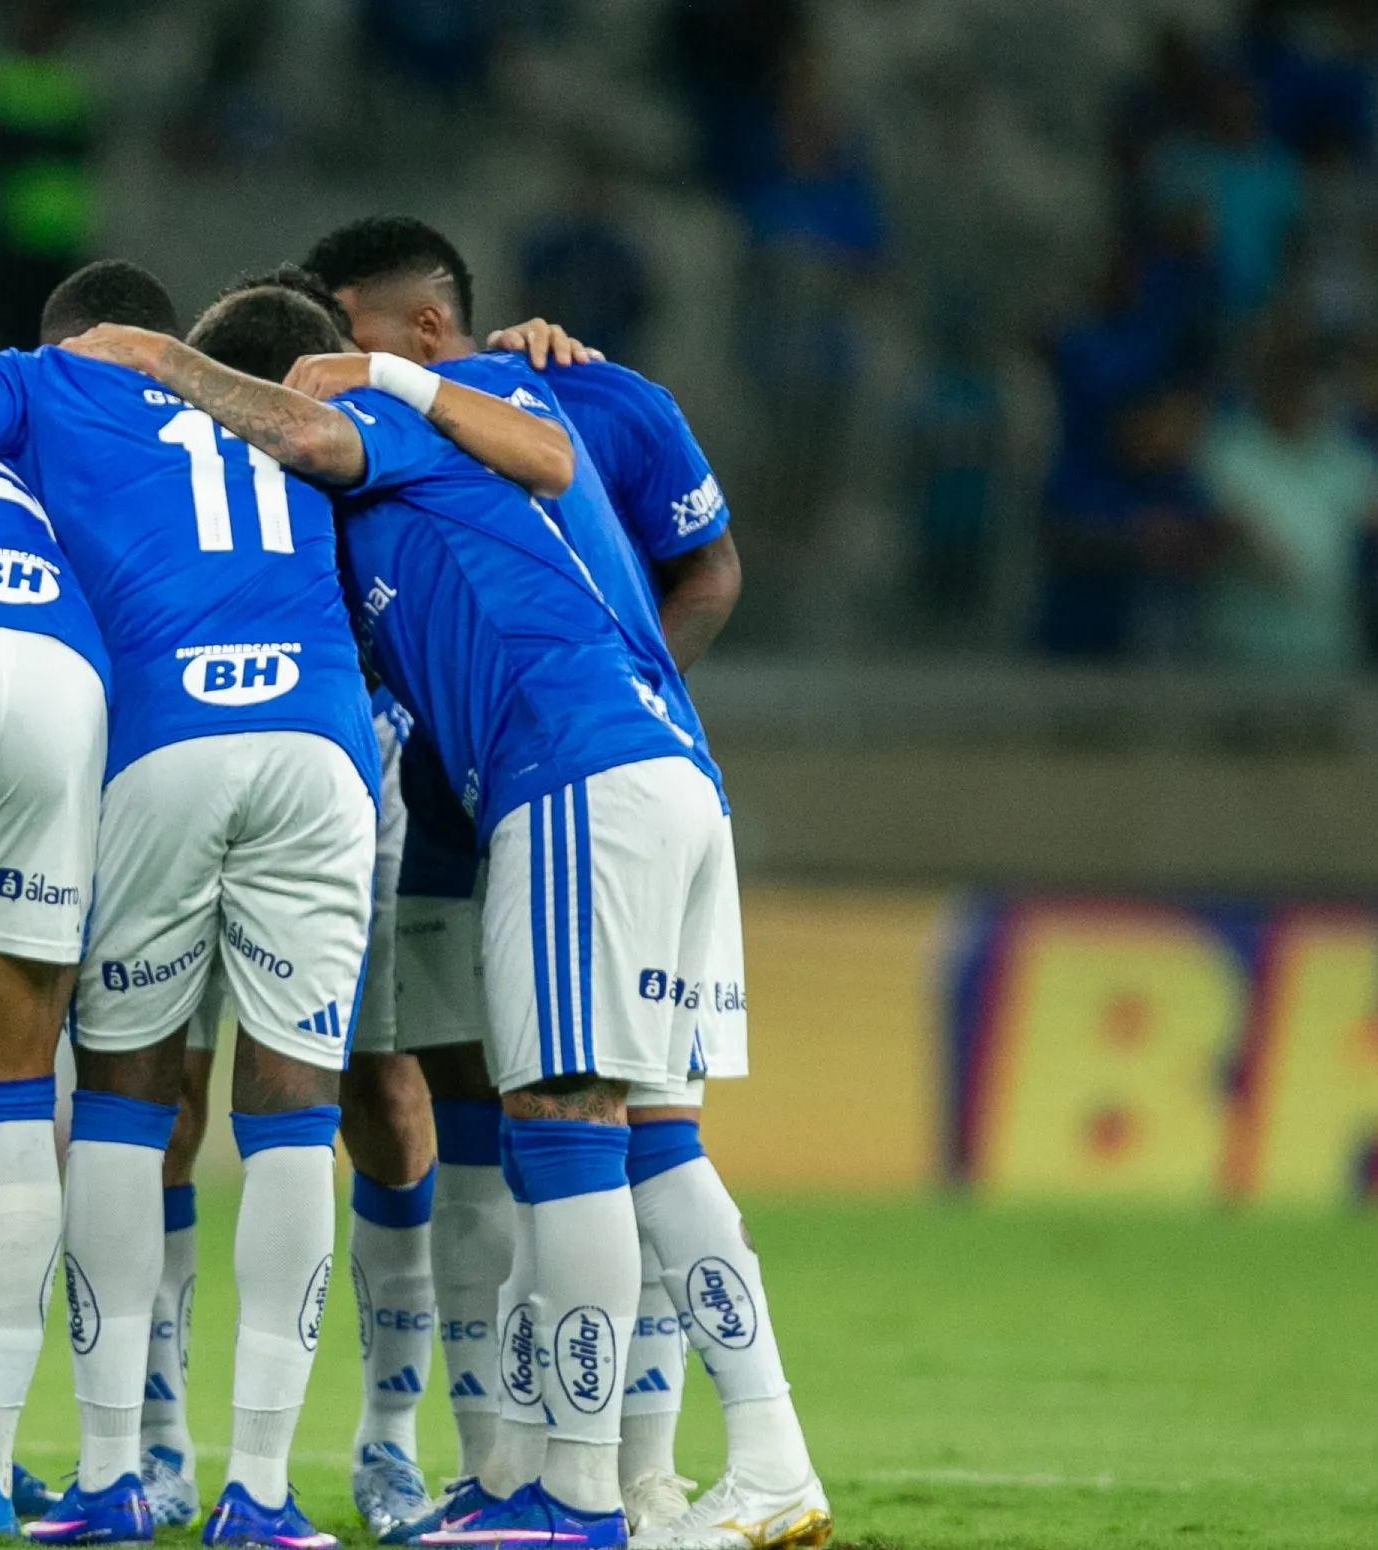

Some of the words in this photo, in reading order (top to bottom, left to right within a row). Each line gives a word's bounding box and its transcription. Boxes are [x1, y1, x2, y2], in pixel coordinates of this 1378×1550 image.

[158, 409, 295, 555] 11
[175, 642, 302, 659] SUPERMERCADOS
[203, 655, 280, 692] BH
[132, 939, 206, 987] álamo
[227, 922, 294, 979] álamo
[375, 1307, 432, 1331] CEC
[631, 1315, 677, 1338] EC
[700, 1265, 747, 1339] Kodilar
[510, 1310, 535, 1395] Kodilar
[569, 1312, 601, 1402] Kodilar
